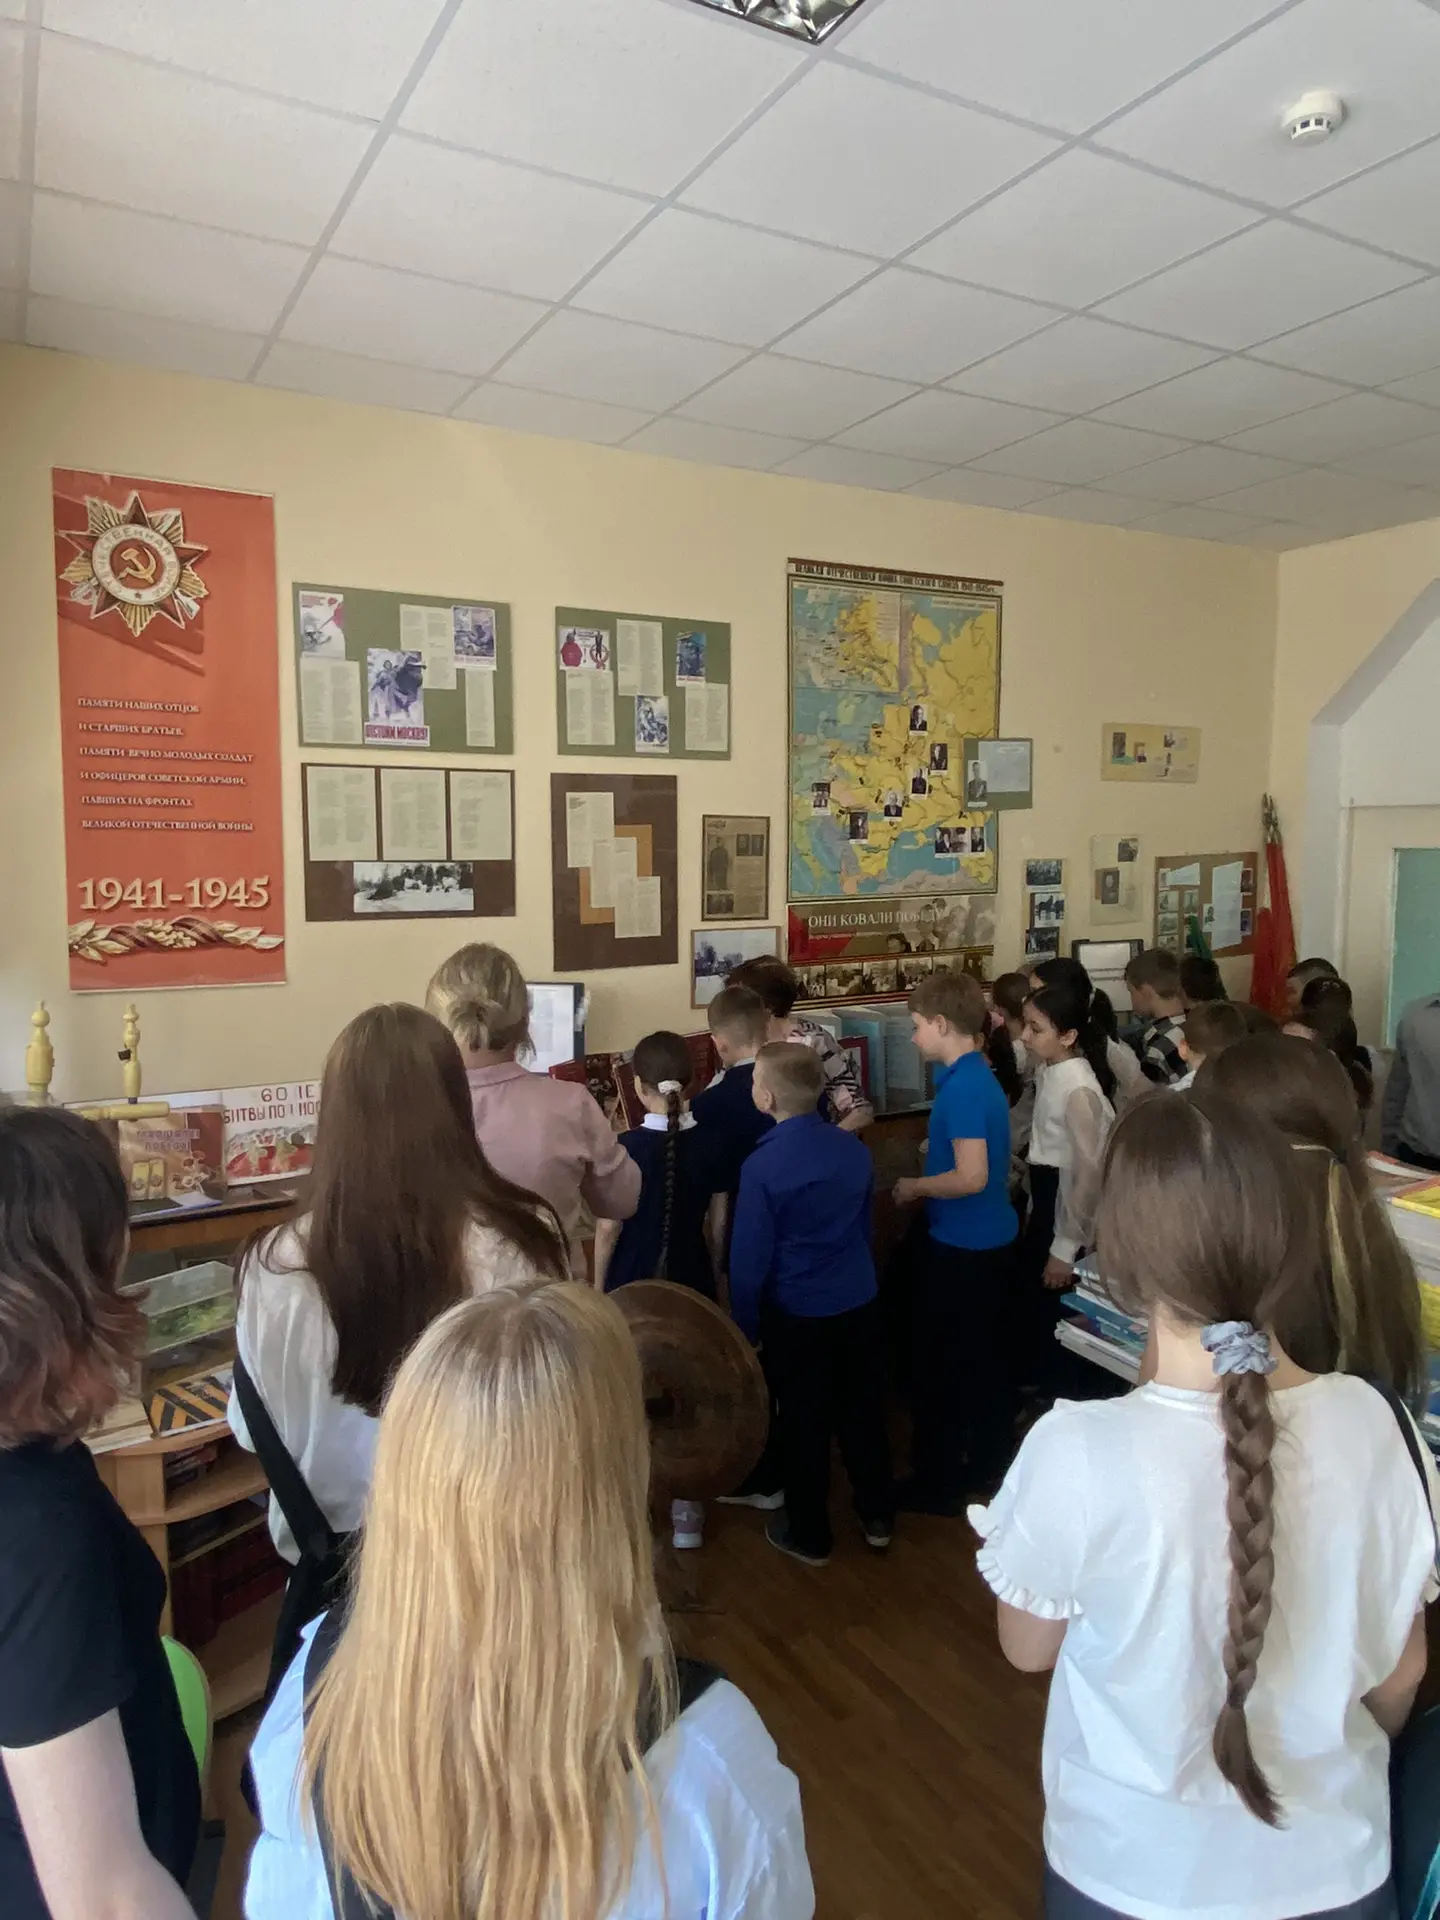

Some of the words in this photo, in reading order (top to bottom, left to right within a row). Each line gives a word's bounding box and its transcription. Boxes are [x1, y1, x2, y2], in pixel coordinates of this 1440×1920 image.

[78, 698, 124, 710] ПАМЯТИ
[125, 701, 164, 712] НАШИХ
[89, 723, 139, 734] СТАРШИХ
[79, 747, 125, 757] ПАМЯТИ
[163, 751, 213, 761] МОЛОДЫХ
[214, 754, 254, 763] СОЛДАТ
[90, 772, 147, 782] ОФИЦЕРОВ
[148, 773, 207, 784] СОВЕТСКОЙ
[81, 795, 127, 804] ПАВШИХ
[128, 797, 143, 805] НА
[81, 820, 131, 829] ВЕЛИКОЙ
[132, 820, 216, 831] ОТЕЧЕСТВЕННОЙ
[217, 821, 253, 831] ВОЙНЫ
[78, 875, 270, 911] 1941-1945
[808, 914, 837, 928] ОНИ
[840, 911, 893, 927] КОВАЛИ
[260, 1086, 288, 1103] 60
